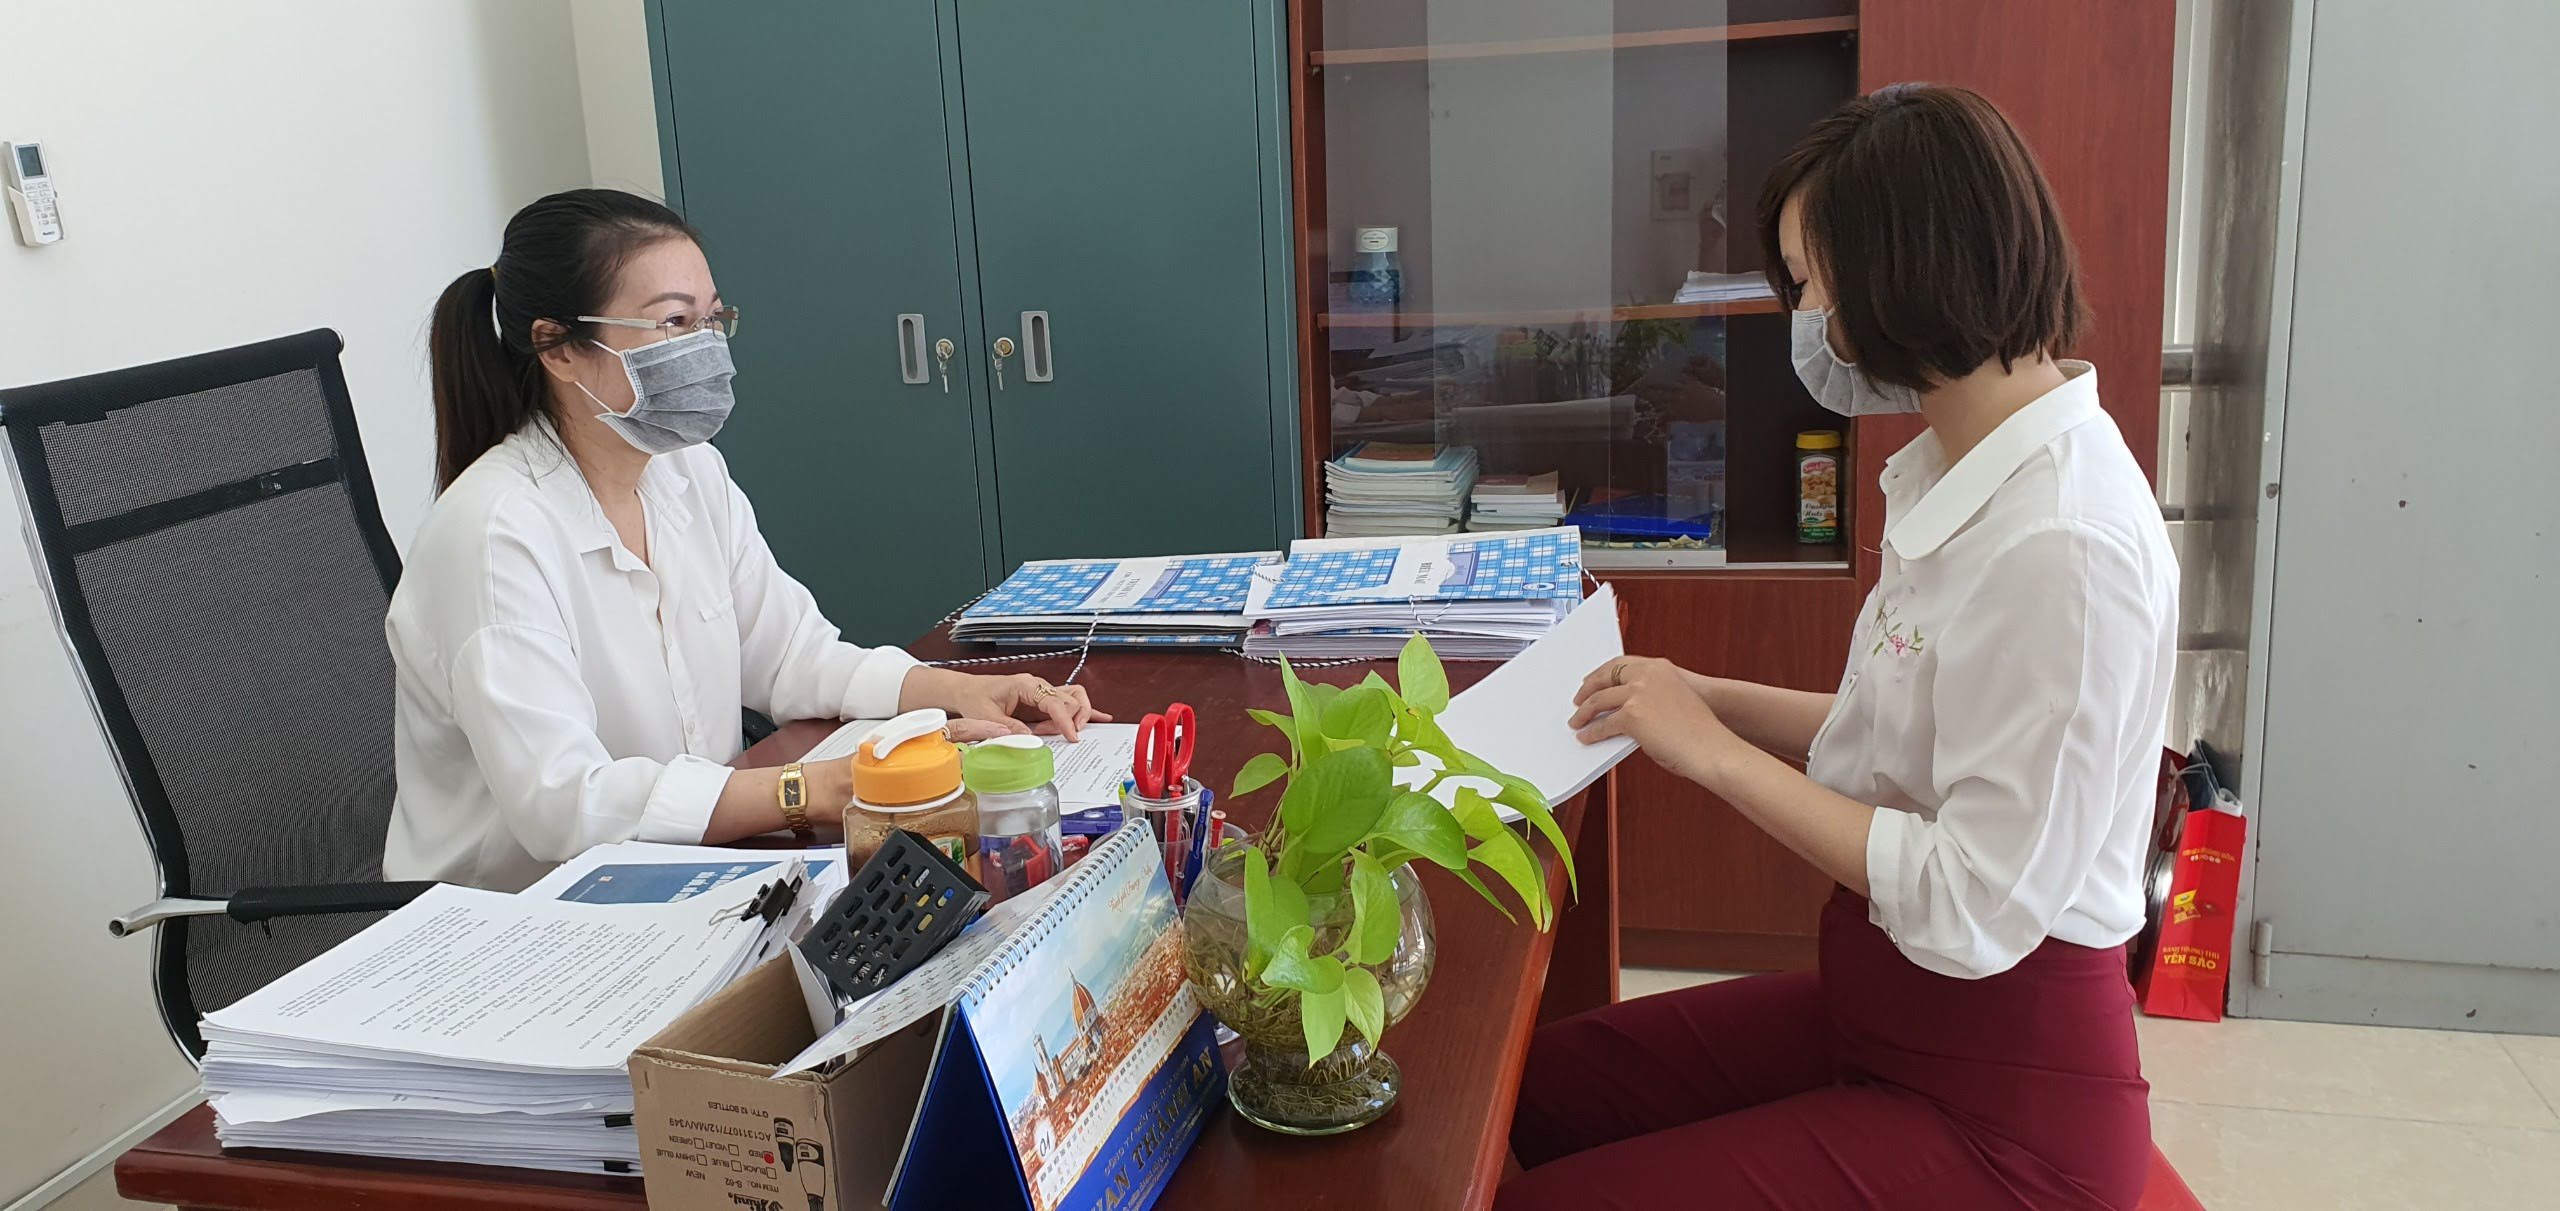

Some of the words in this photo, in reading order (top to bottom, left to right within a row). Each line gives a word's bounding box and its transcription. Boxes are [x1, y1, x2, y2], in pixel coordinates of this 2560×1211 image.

[669, 1135, 693, 1145] GREEN
[705, 1141, 728, 1151] VIOLET
[748, 1149, 763, 1158] RED
[711, 1158, 730, 1168] BLUE
